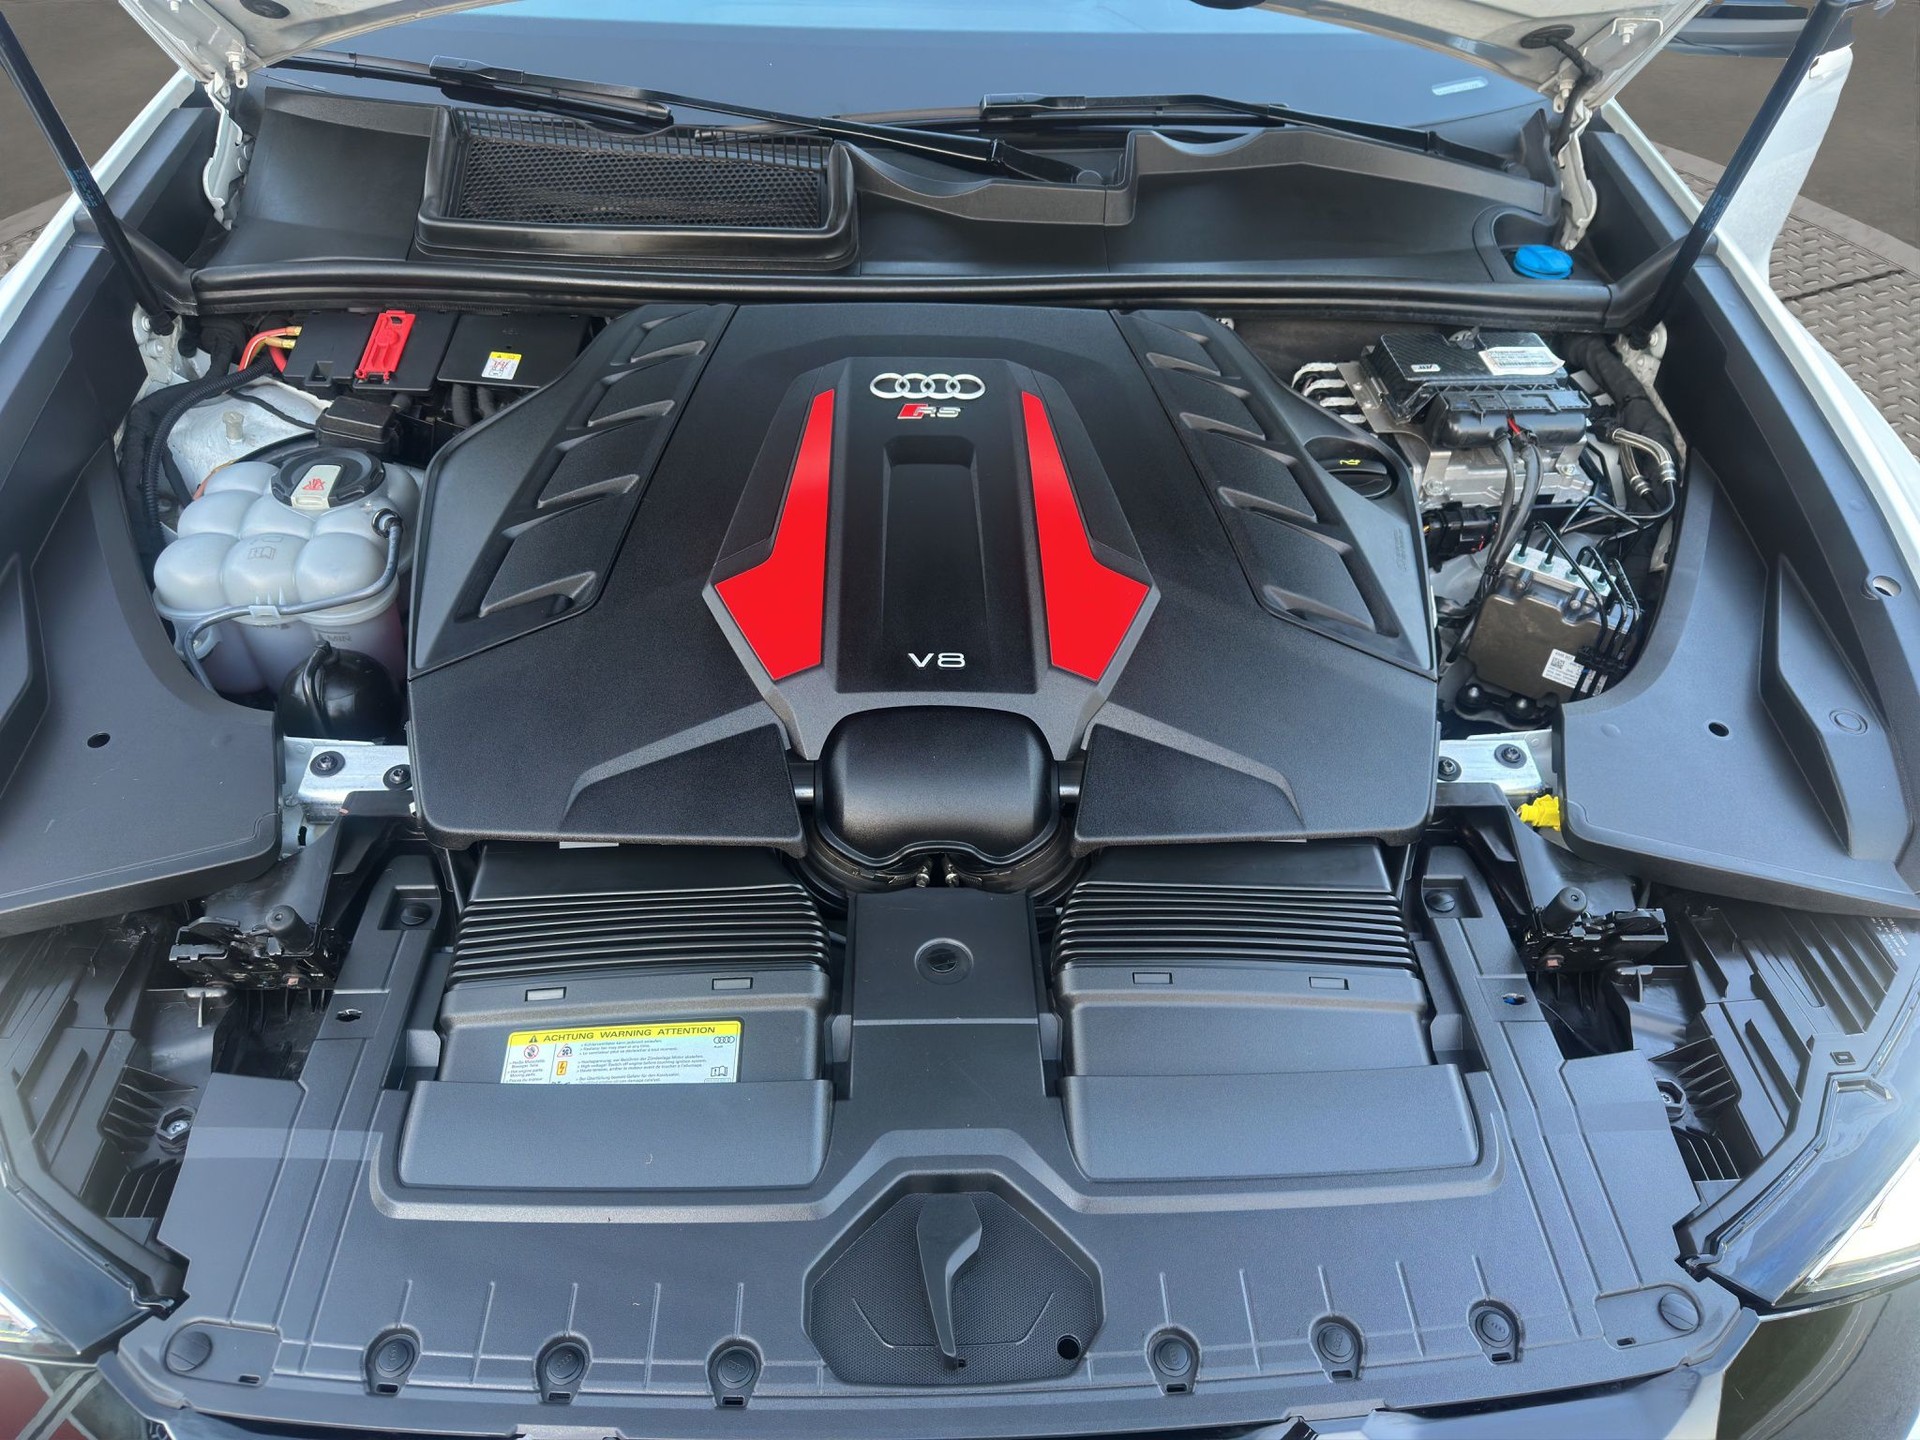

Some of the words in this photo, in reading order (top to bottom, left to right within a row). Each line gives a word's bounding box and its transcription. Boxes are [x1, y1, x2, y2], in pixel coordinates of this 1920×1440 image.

[911, 404, 961, 419] RS
[907, 652, 966, 669] V8
[543, 1032, 594, 1042] ACHTUNG
[600, 1029, 652, 1039] WARNING
[657, 1025, 716, 1036] ATTENTION
